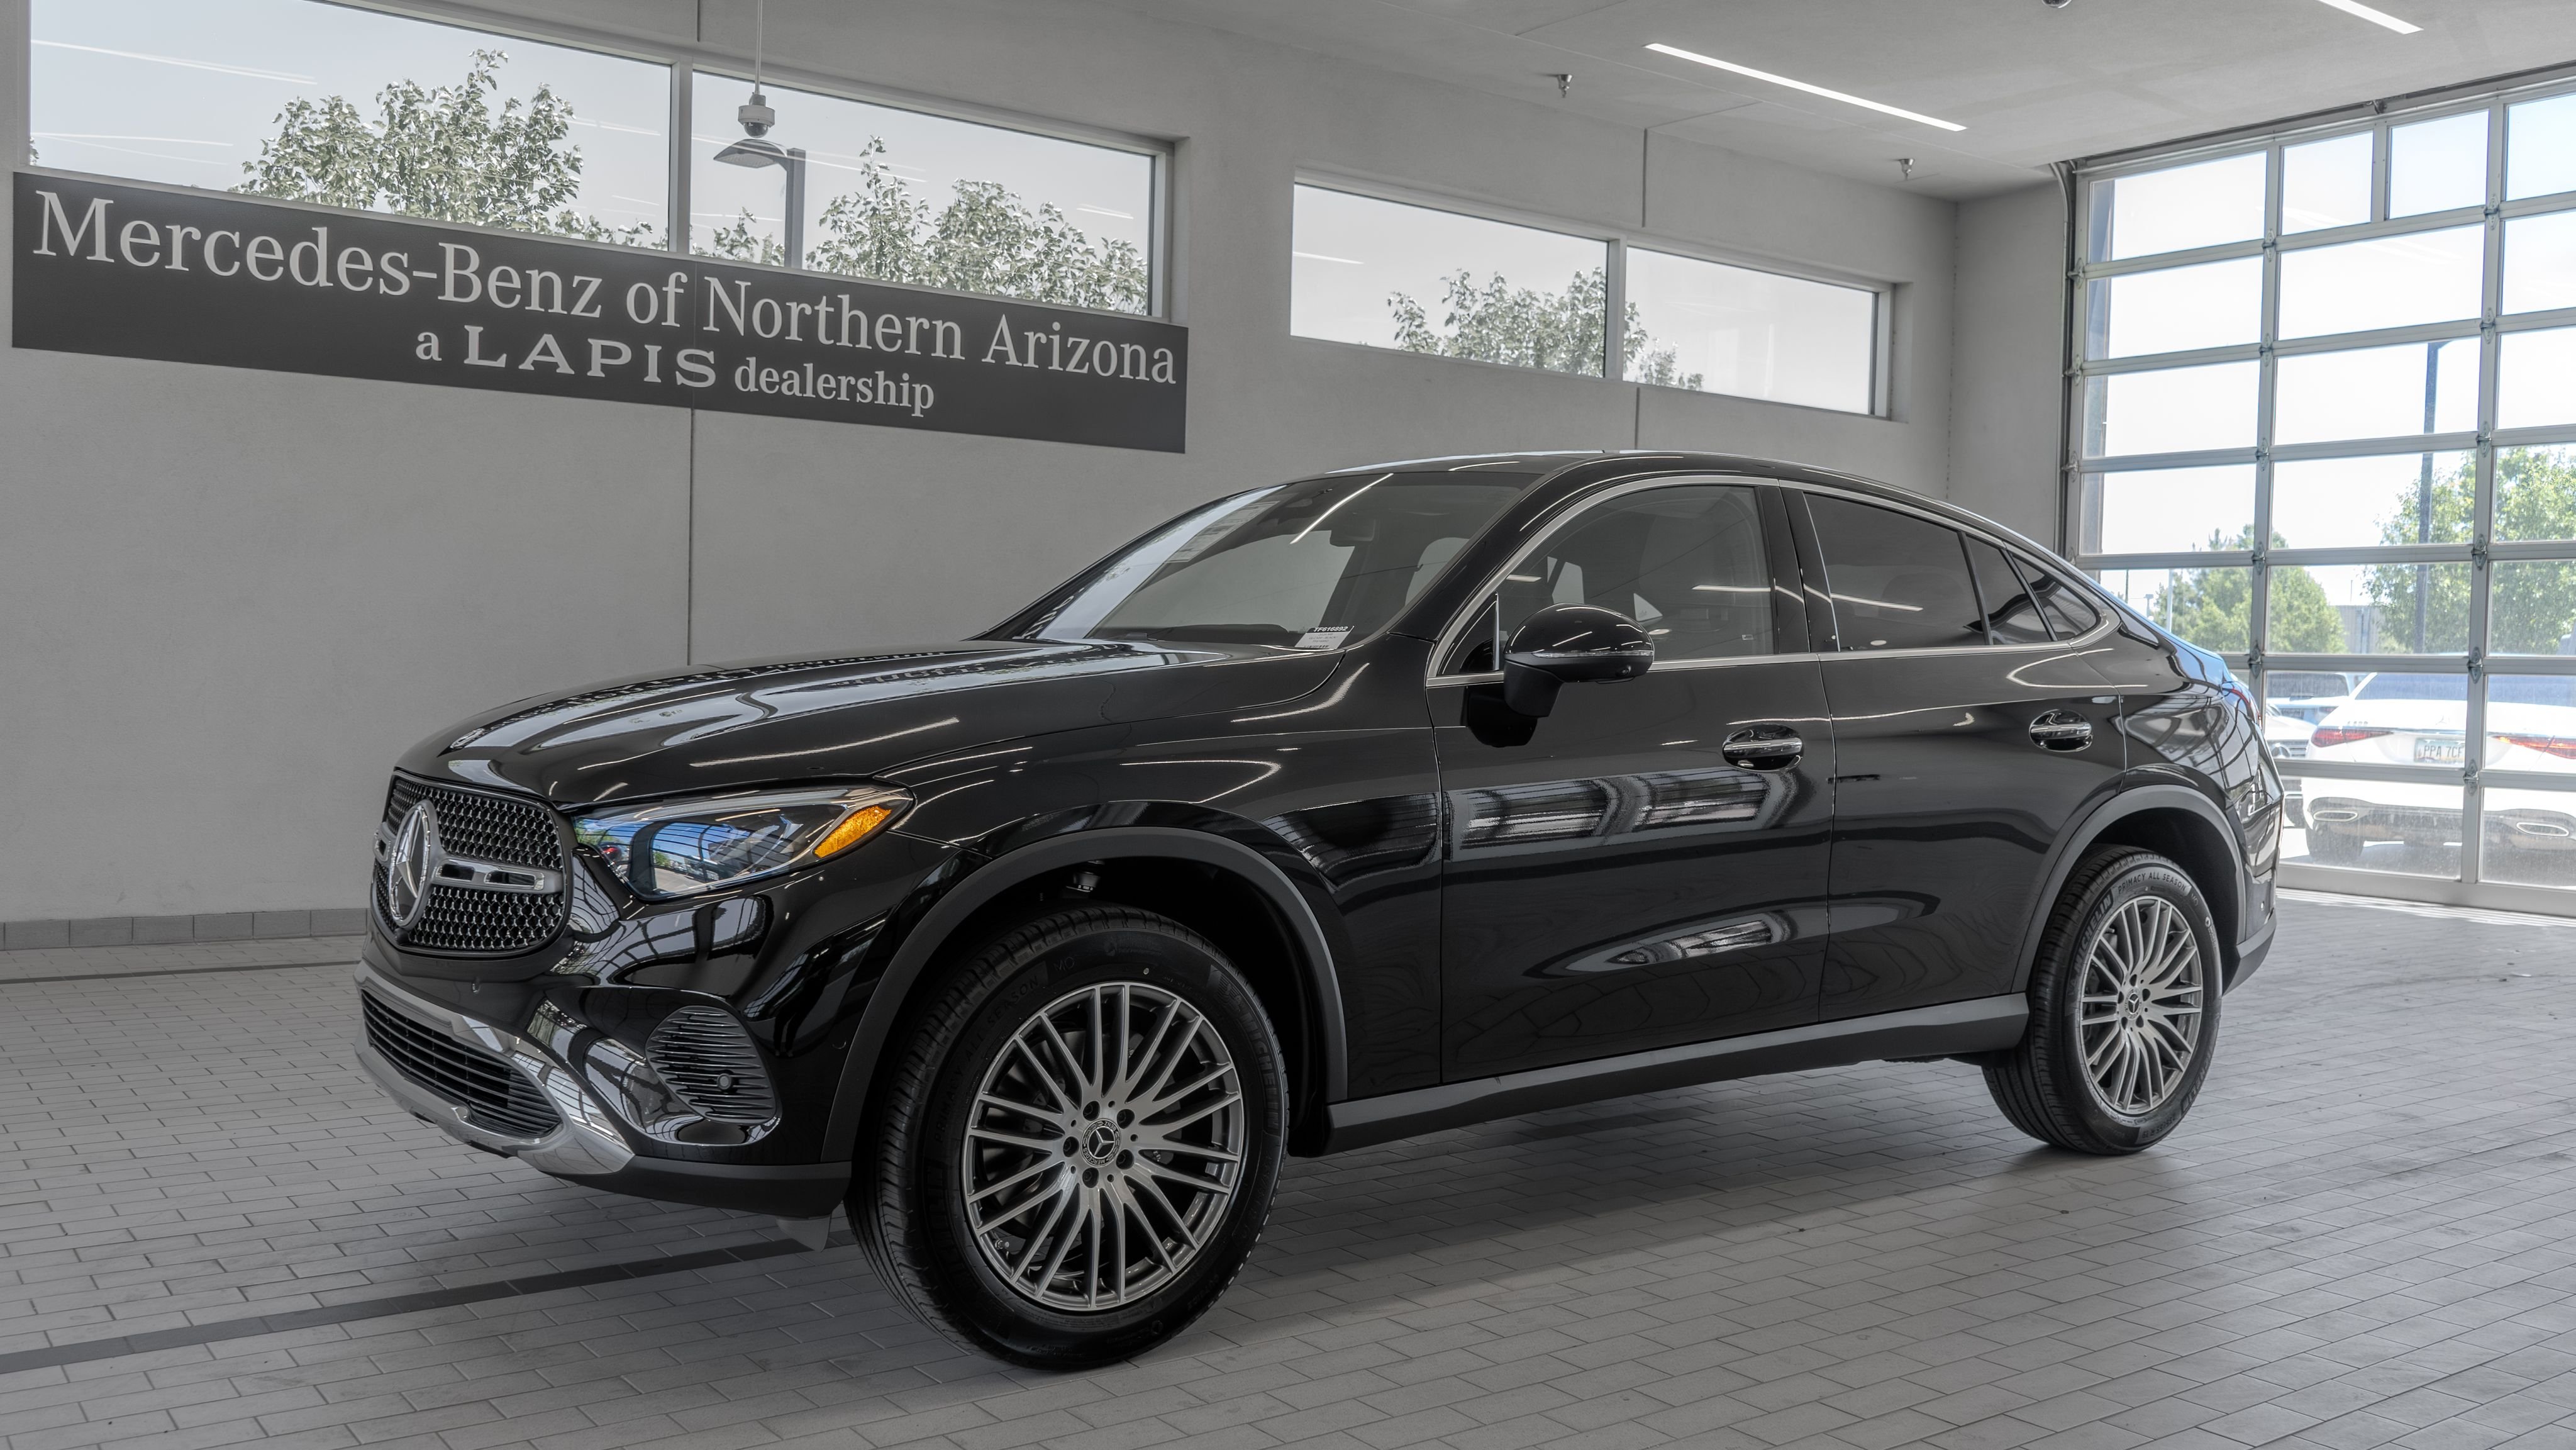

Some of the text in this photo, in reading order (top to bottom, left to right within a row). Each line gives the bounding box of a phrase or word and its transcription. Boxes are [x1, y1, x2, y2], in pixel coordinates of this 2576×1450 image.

[33, 191, 1177, 384] Mercedes-Benz of Northern Arizona
[416, 325, 935, 417] a LAPIS dealership
[2118, 873, 2146, 894] PRIMACY
[2162, 874, 2186, 891] SEASON
[2074, 894, 2112, 974] MICHELIN
[987, 975, 1039, 1025] SEASON
[1104, 1121, 1117, 1132] BENZ
[1082, 1147, 1106, 1164] MERCEDES
